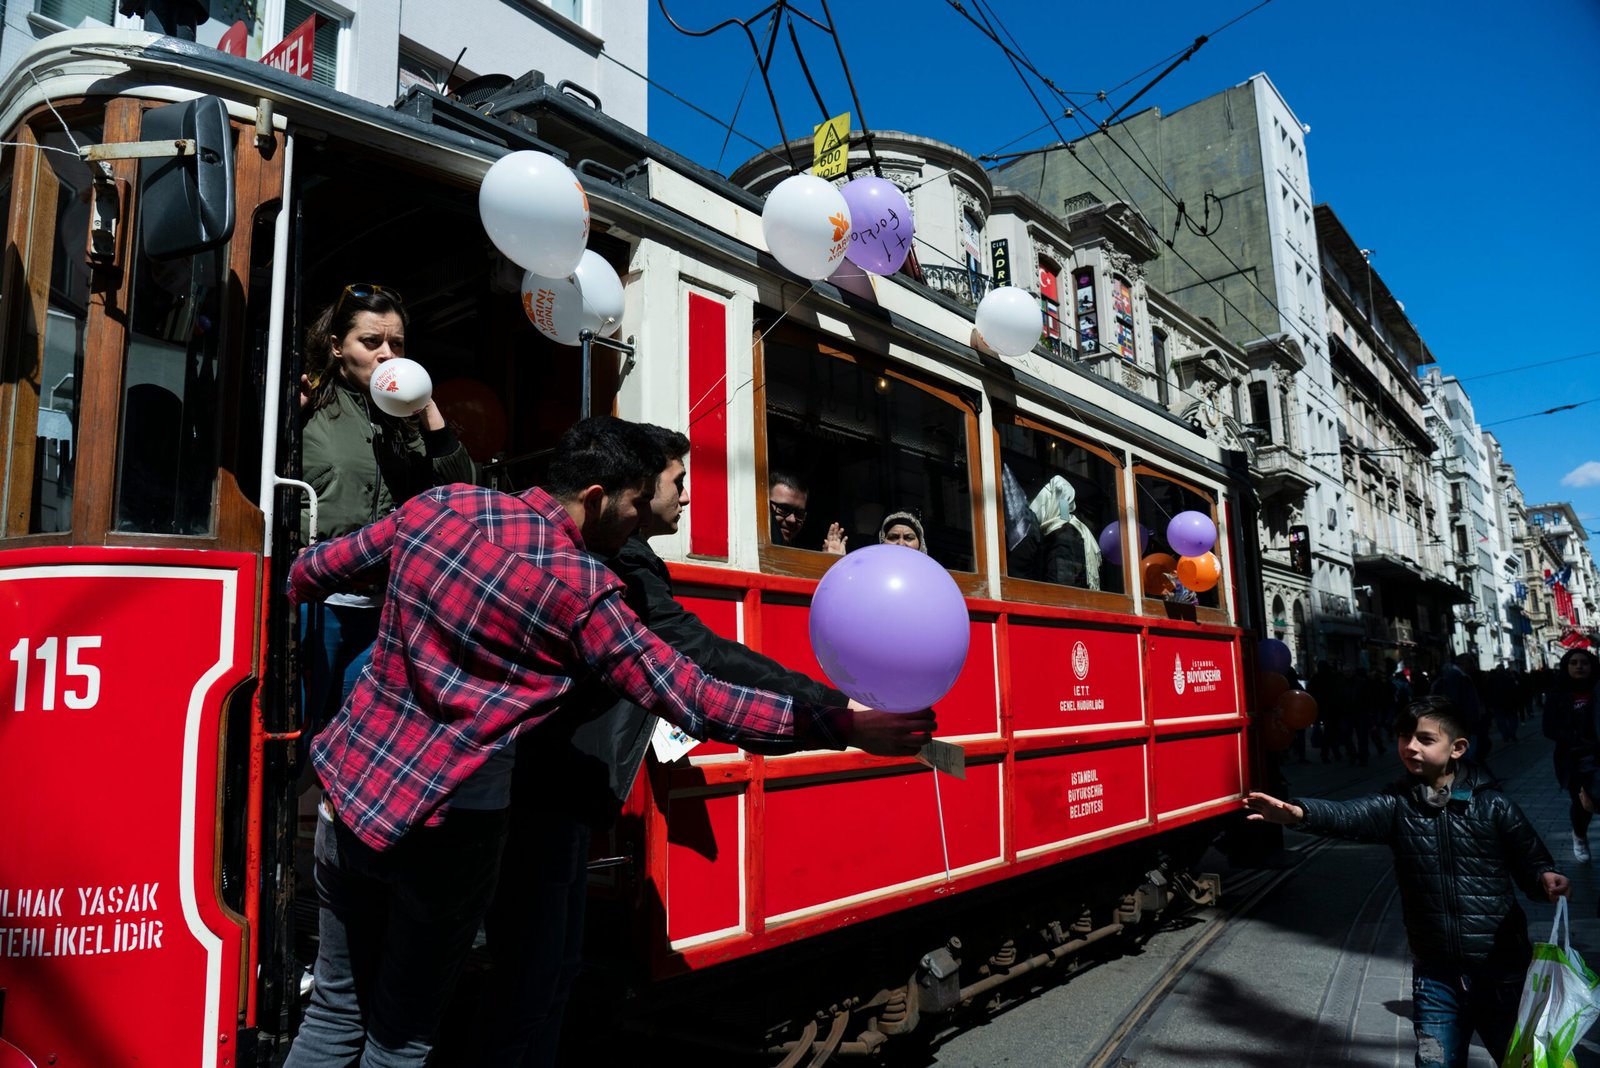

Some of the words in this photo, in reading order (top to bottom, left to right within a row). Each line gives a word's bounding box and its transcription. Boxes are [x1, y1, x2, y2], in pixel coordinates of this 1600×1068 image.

[819, 149, 841, 168] 600
[535, 288, 548, 332] YARINI
[544, 289, 559, 337] AYDINLAT
[9, 635, 102, 711] 115
[1186, 667, 1222, 685] BÜYÜKŞEHİR
[1060, 700, 1076, 711] GENEL
[1071, 769, 1099, 785] İSTANBUL
[78, 882, 159, 916] YASAK
